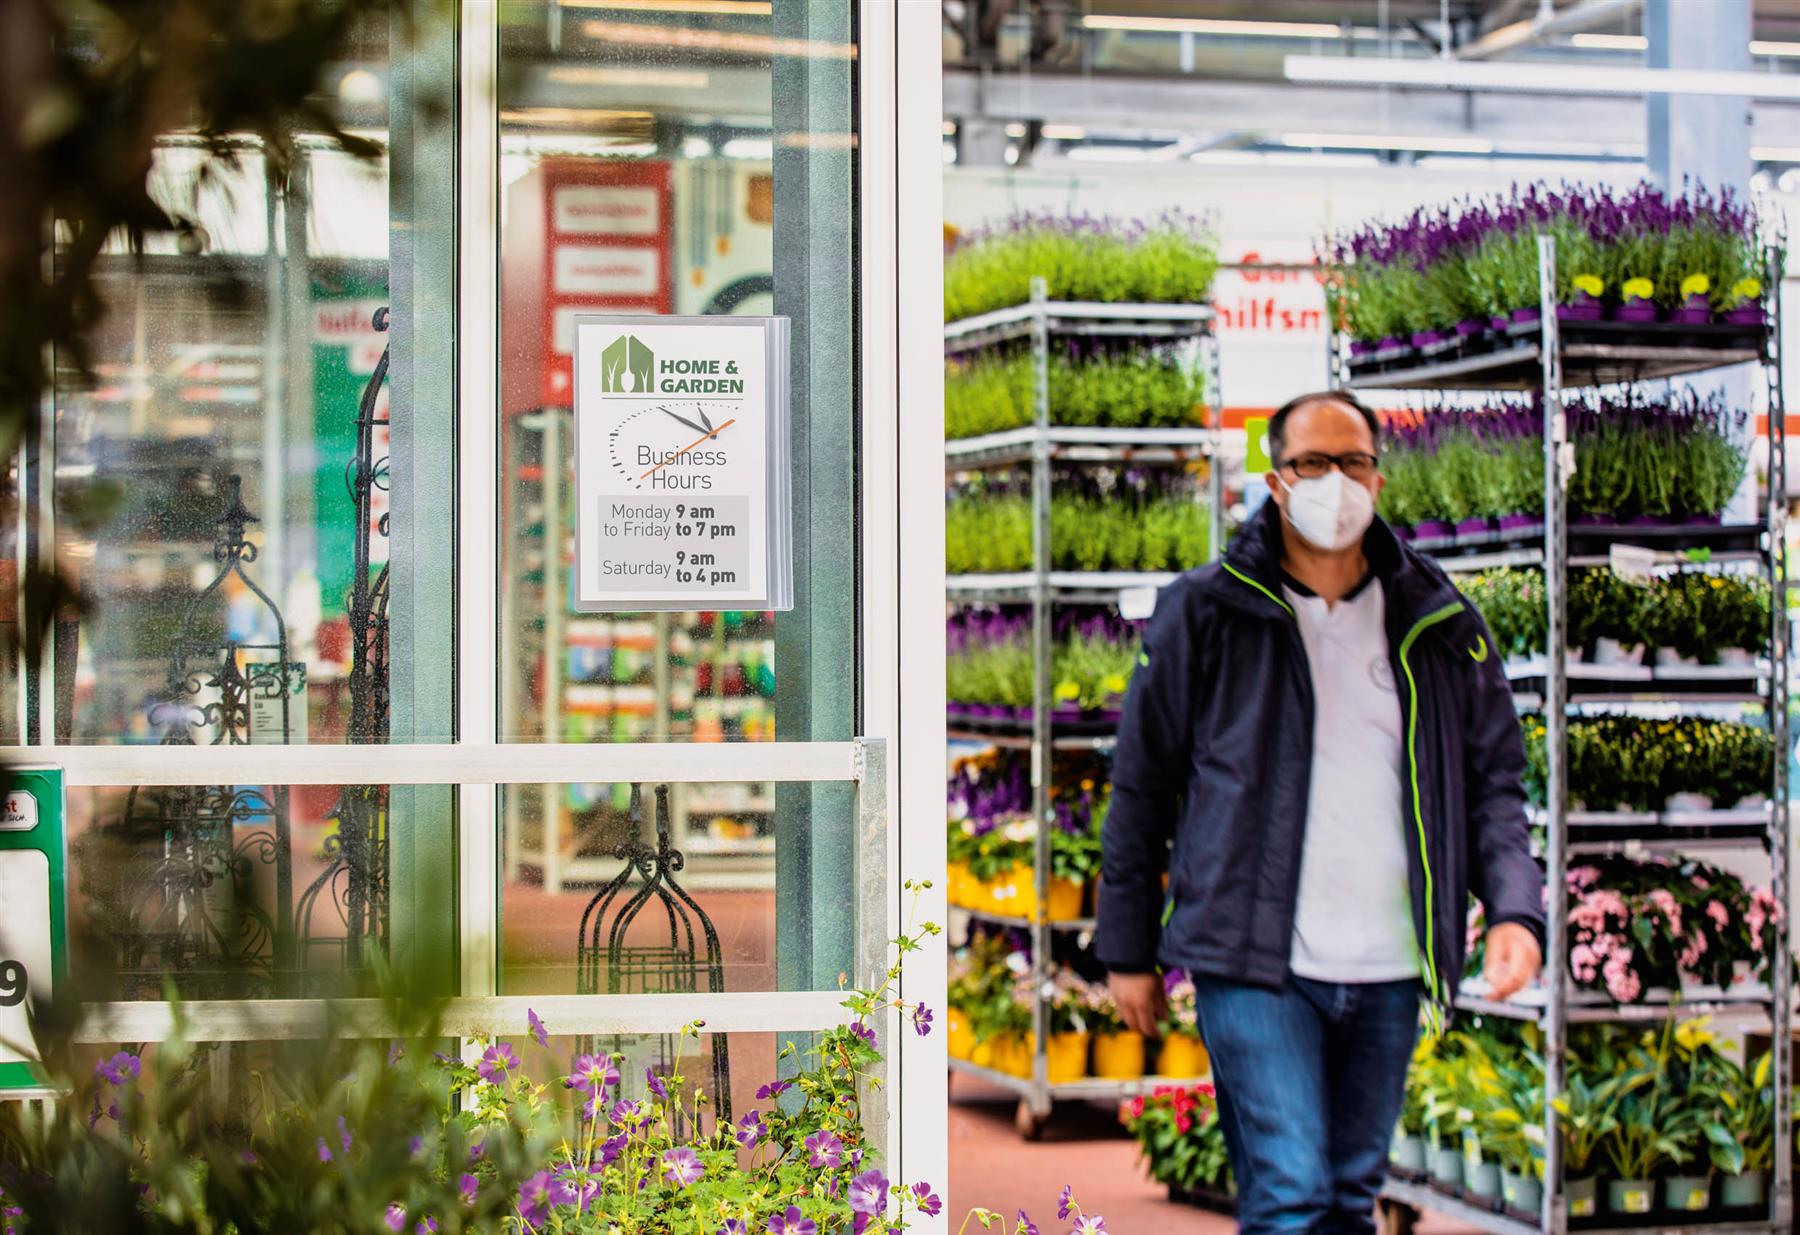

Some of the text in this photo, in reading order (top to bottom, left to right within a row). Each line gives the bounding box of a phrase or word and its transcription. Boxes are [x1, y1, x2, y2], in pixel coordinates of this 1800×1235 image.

[660, 360, 739, 375] HOME &
[660, 379, 744, 393] GARDEN
[637, 445, 727, 466] Business
[651, 469, 712, 489] Hours
[611, 503, 715, 523] Monday 9 am
[603, 521, 736, 541] to Friday to 7 pm
[675, 551, 715, 566] 9 am
[602, 560, 671, 579] Saturday
[675, 568, 736, 586] to 4 pm
